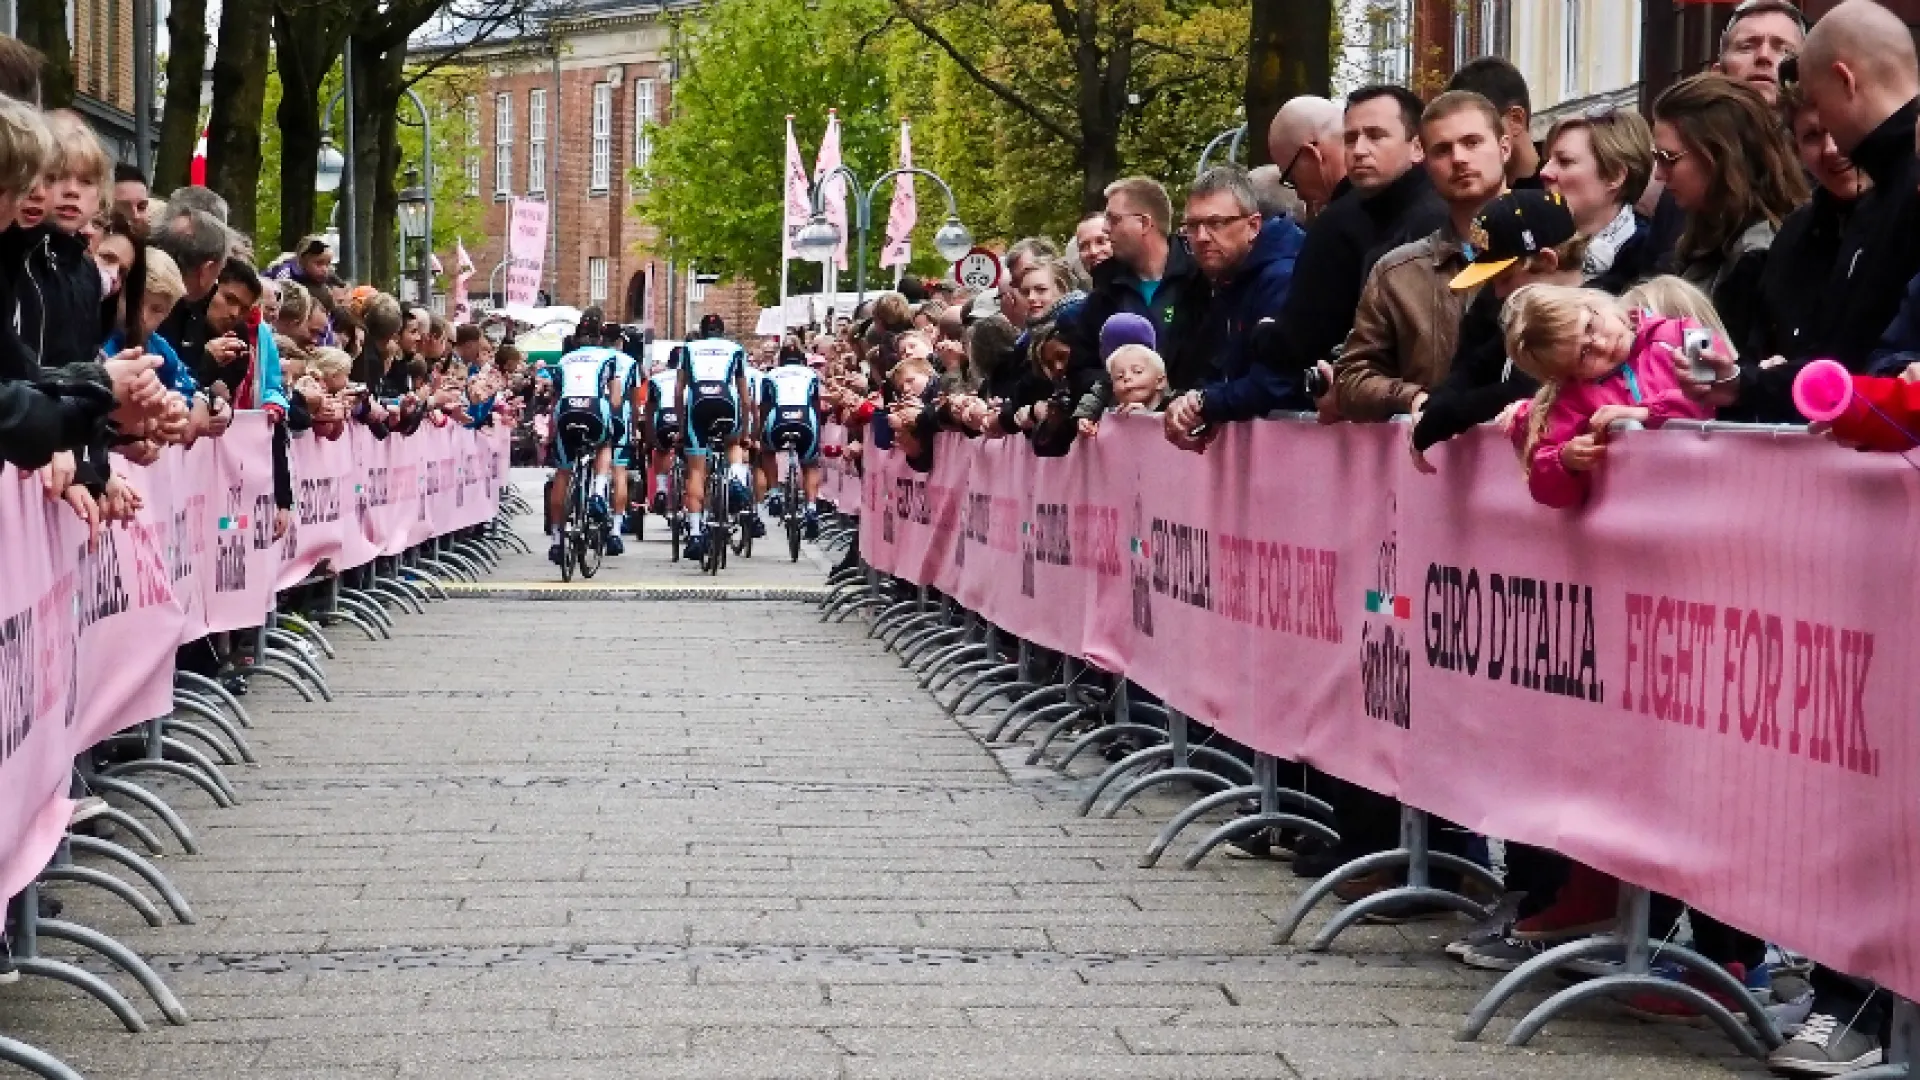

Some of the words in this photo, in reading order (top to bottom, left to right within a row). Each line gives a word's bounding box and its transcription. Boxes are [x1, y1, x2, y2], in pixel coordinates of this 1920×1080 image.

[1256, 541, 1291, 633] FOR
[1424, 562, 1482, 677] GIRO
[1488, 573, 1604, 704] D'ITALIA.
[1622, 592, 1716, 729] FIGHT
[1718, 607, 1783, 749] FOR
[1789, 620, 1879, 777] PINK.
